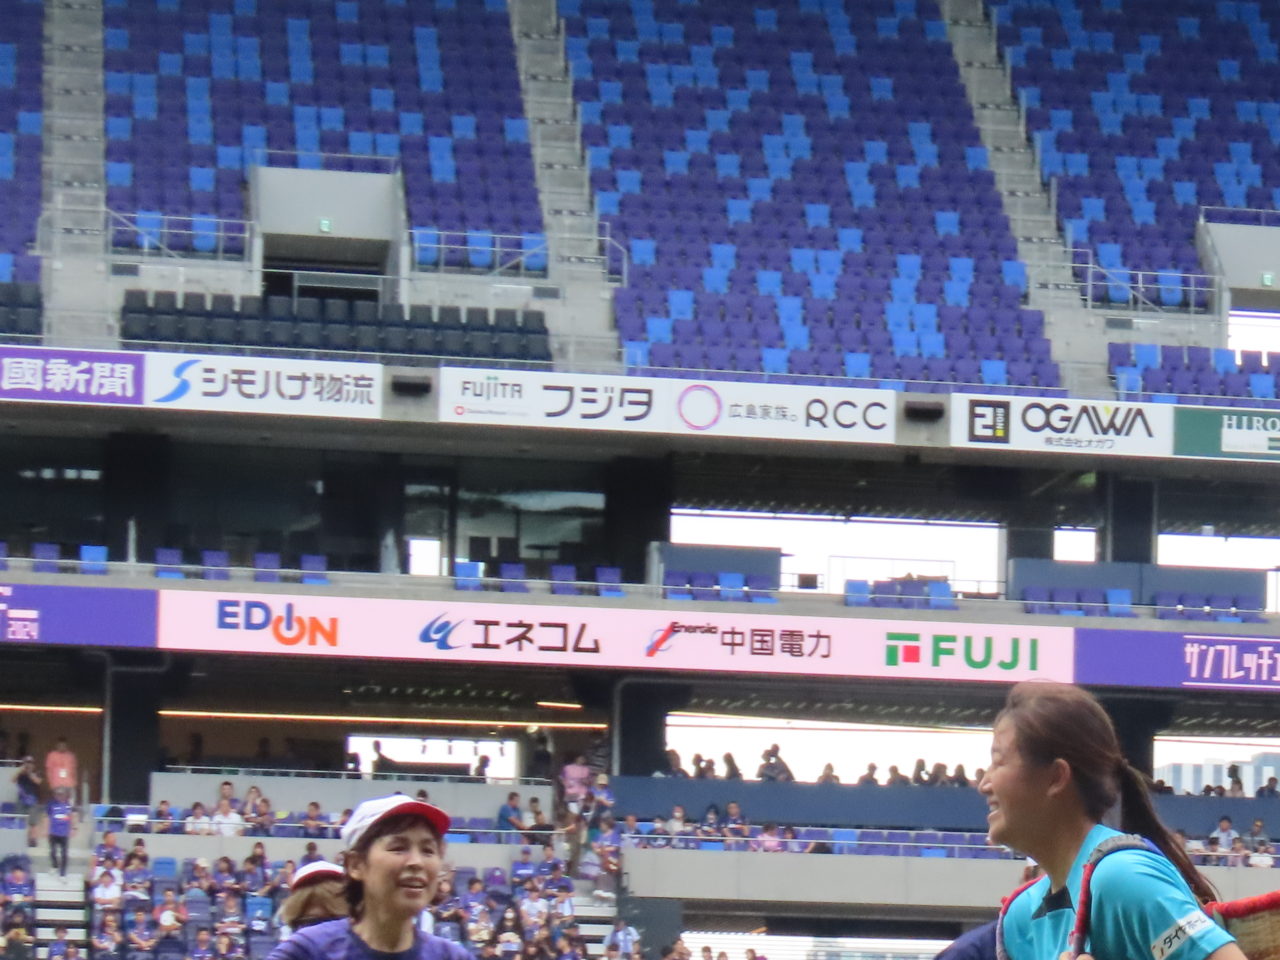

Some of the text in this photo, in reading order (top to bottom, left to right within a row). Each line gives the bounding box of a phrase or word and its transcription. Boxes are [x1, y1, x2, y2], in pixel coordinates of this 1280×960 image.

[201, 368, 375, 405] シモハナ物流
[542, 384, 653, 421] フジタ
[805, 399, 887, 430] RCC
[1021, 402, 1154, 438] OGAWA
[217, 600, 338, 647] EDION
[472, 620, 600, 653] エネコム
[721, 627, 831, 658] 中国電力
[931, 635, 1038, 671] FUJI
